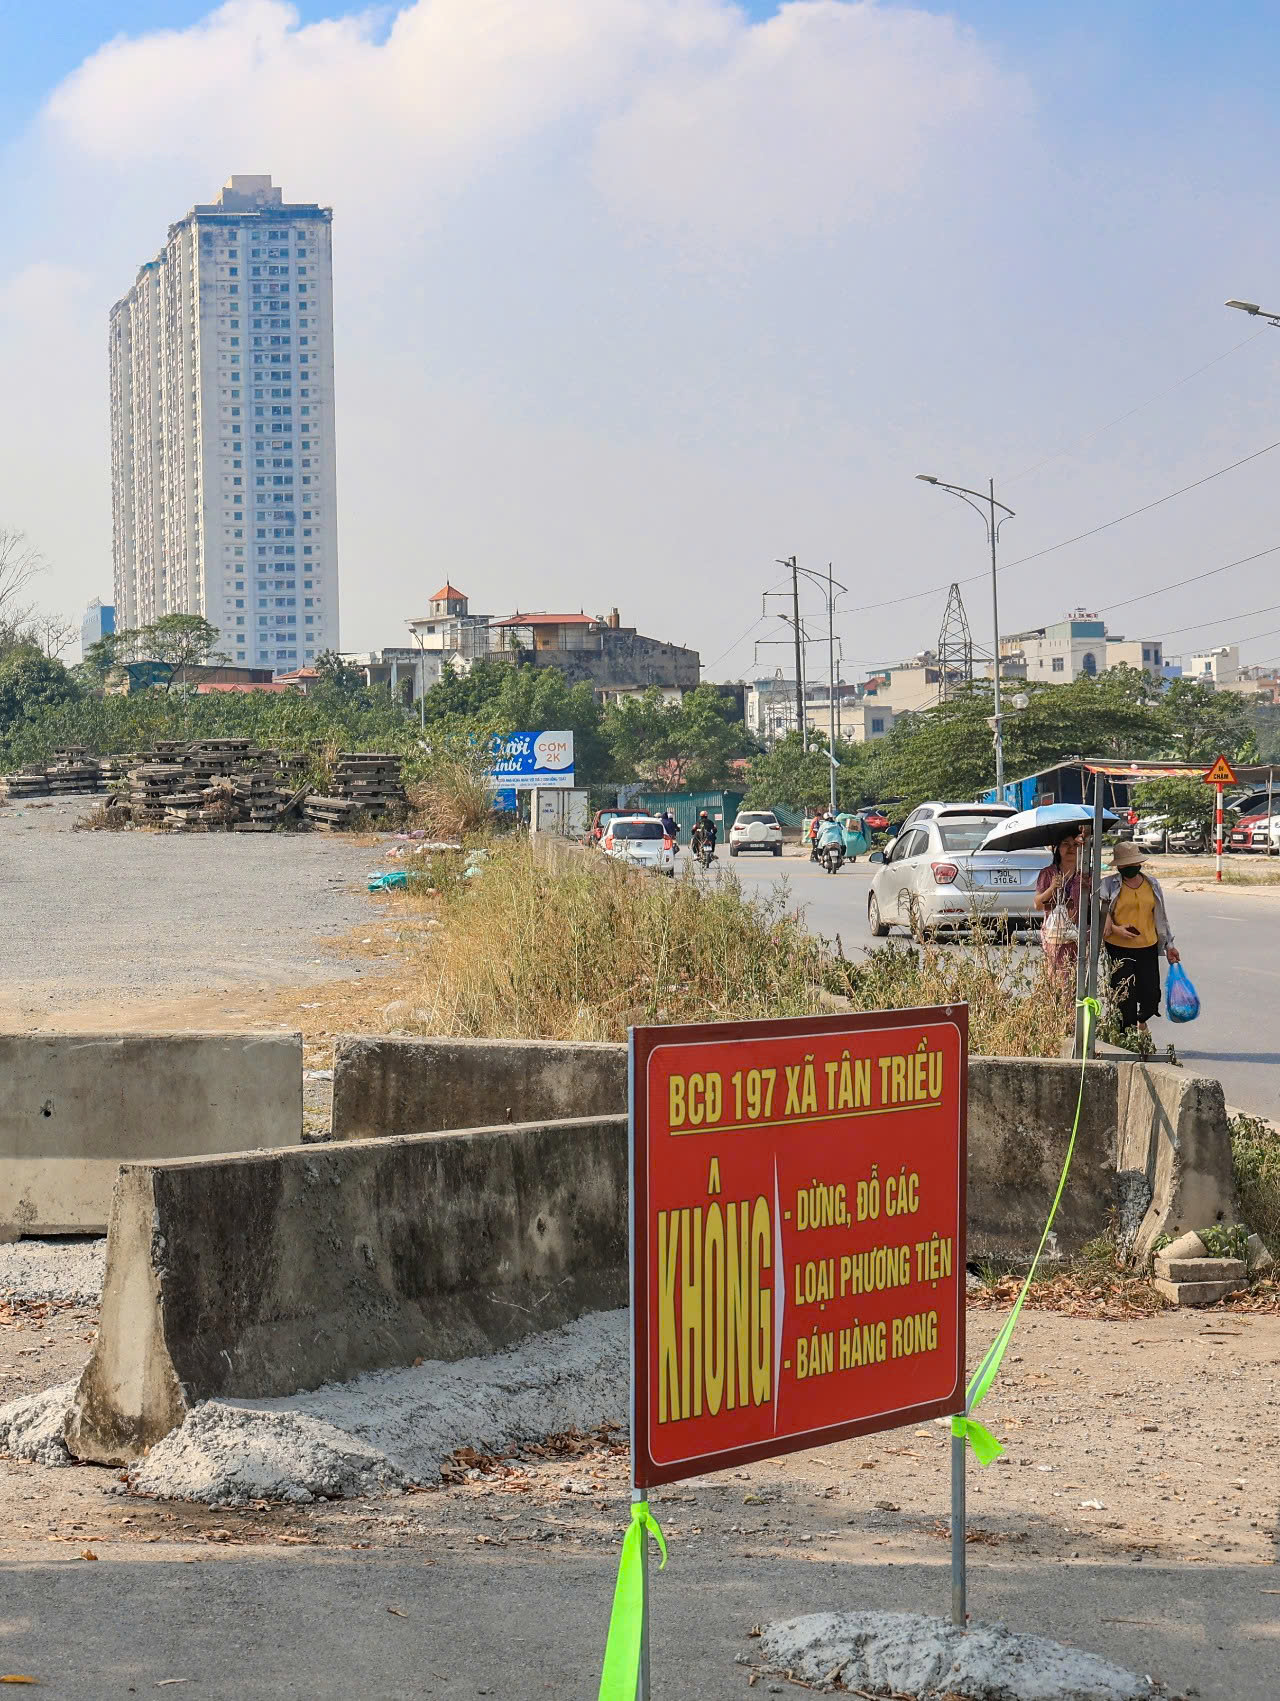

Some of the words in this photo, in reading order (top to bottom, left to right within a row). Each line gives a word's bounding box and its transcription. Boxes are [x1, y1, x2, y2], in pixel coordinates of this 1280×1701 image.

[546, 753, 561, 763] 2K
[668, 1071, 723, 1127] BCĐ
[731, 1067, 778, 1121] 197
[783, 1053, 818, 1116] XÃ
[824, 1049, 872, 1111] TÂN
[878, 1036, 943, 1105] TRIỀU
[796, 1178, 852, 1232] DỪNG,
[856, 1163, 880, 1222] ĐỖ
[885, 1165, 920, 1217] CÁC
[657, 1156, 772, 1425] KHÔNG
[795, 1257, 836, 1311] LOẠI
[840, 1244, 911, 1298] PHƯƠNG
[915, 1231, 953, 1290] TIỆN
[796, 1325, 835, 1380] BÁN
[839, 1317, 888, 1371] HÀNG
[891, 1310, 939, 1360] RONG
